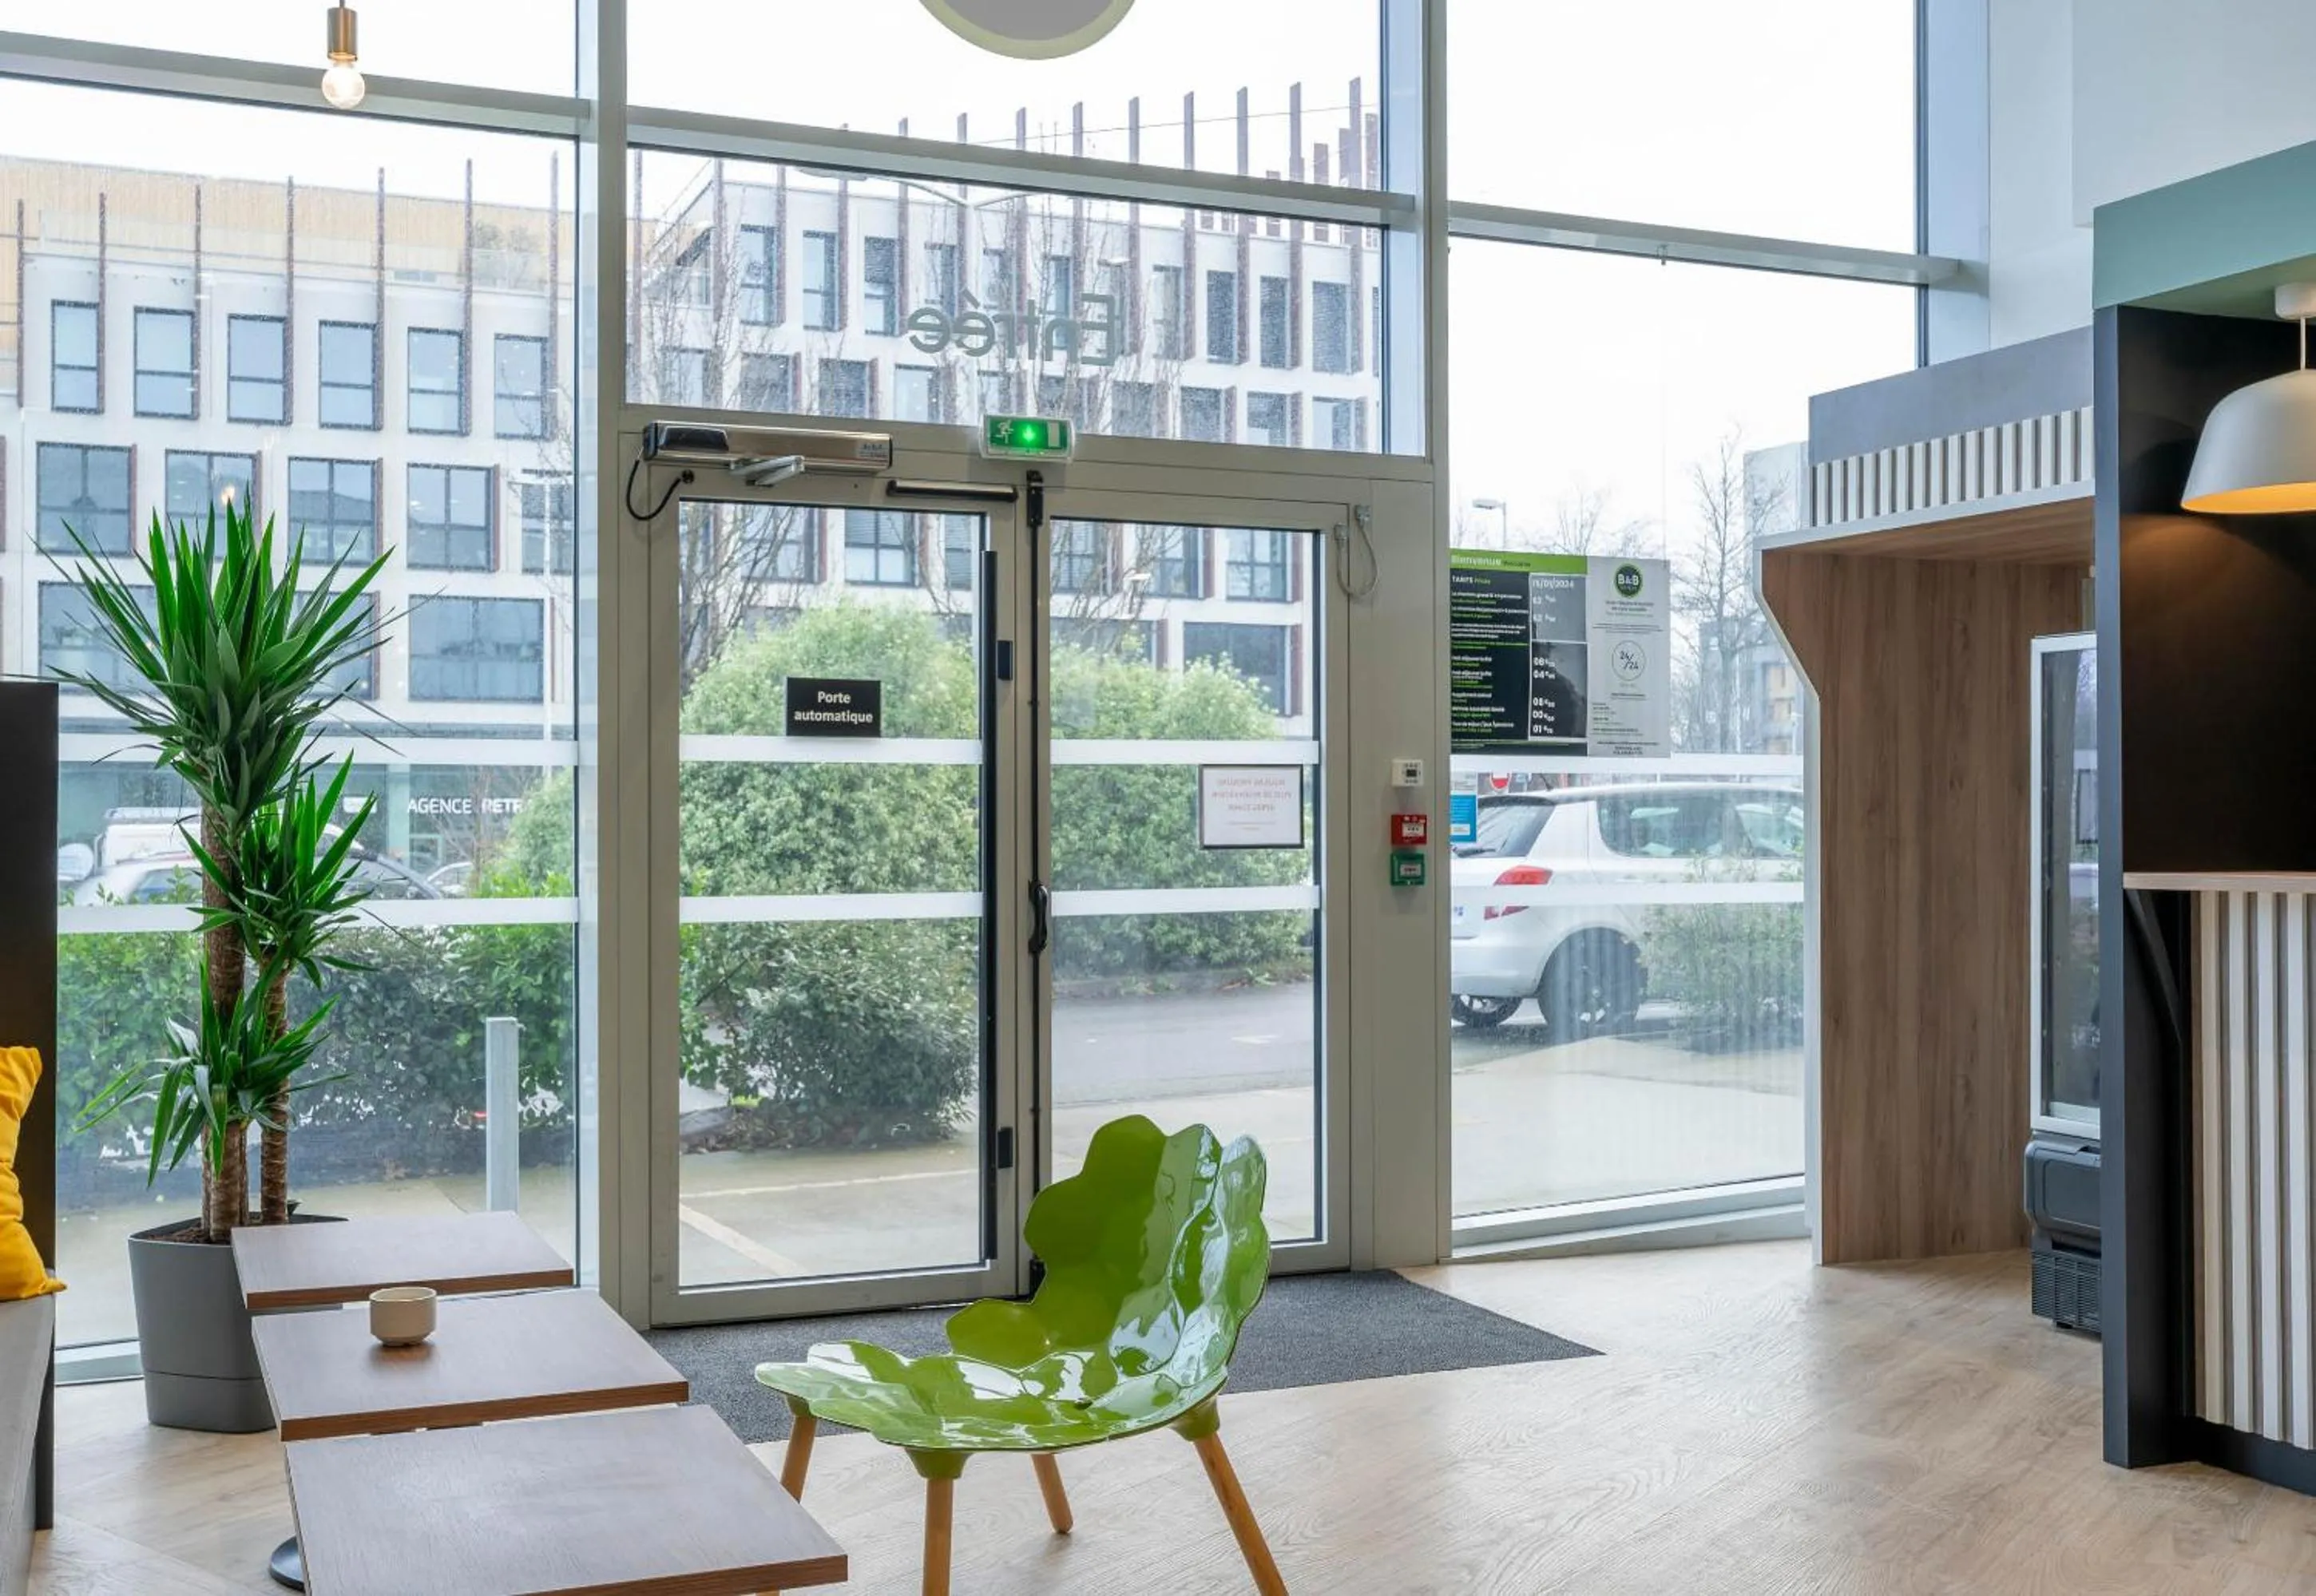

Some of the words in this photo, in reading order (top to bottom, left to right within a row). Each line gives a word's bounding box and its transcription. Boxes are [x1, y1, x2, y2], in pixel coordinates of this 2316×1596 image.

[1617, 573, 1639, 586] B&B
[817, 691, 851, 704] Porte
[794, 710, 874, 725] automatique
[407, 798, 472, 814] AGENCE
